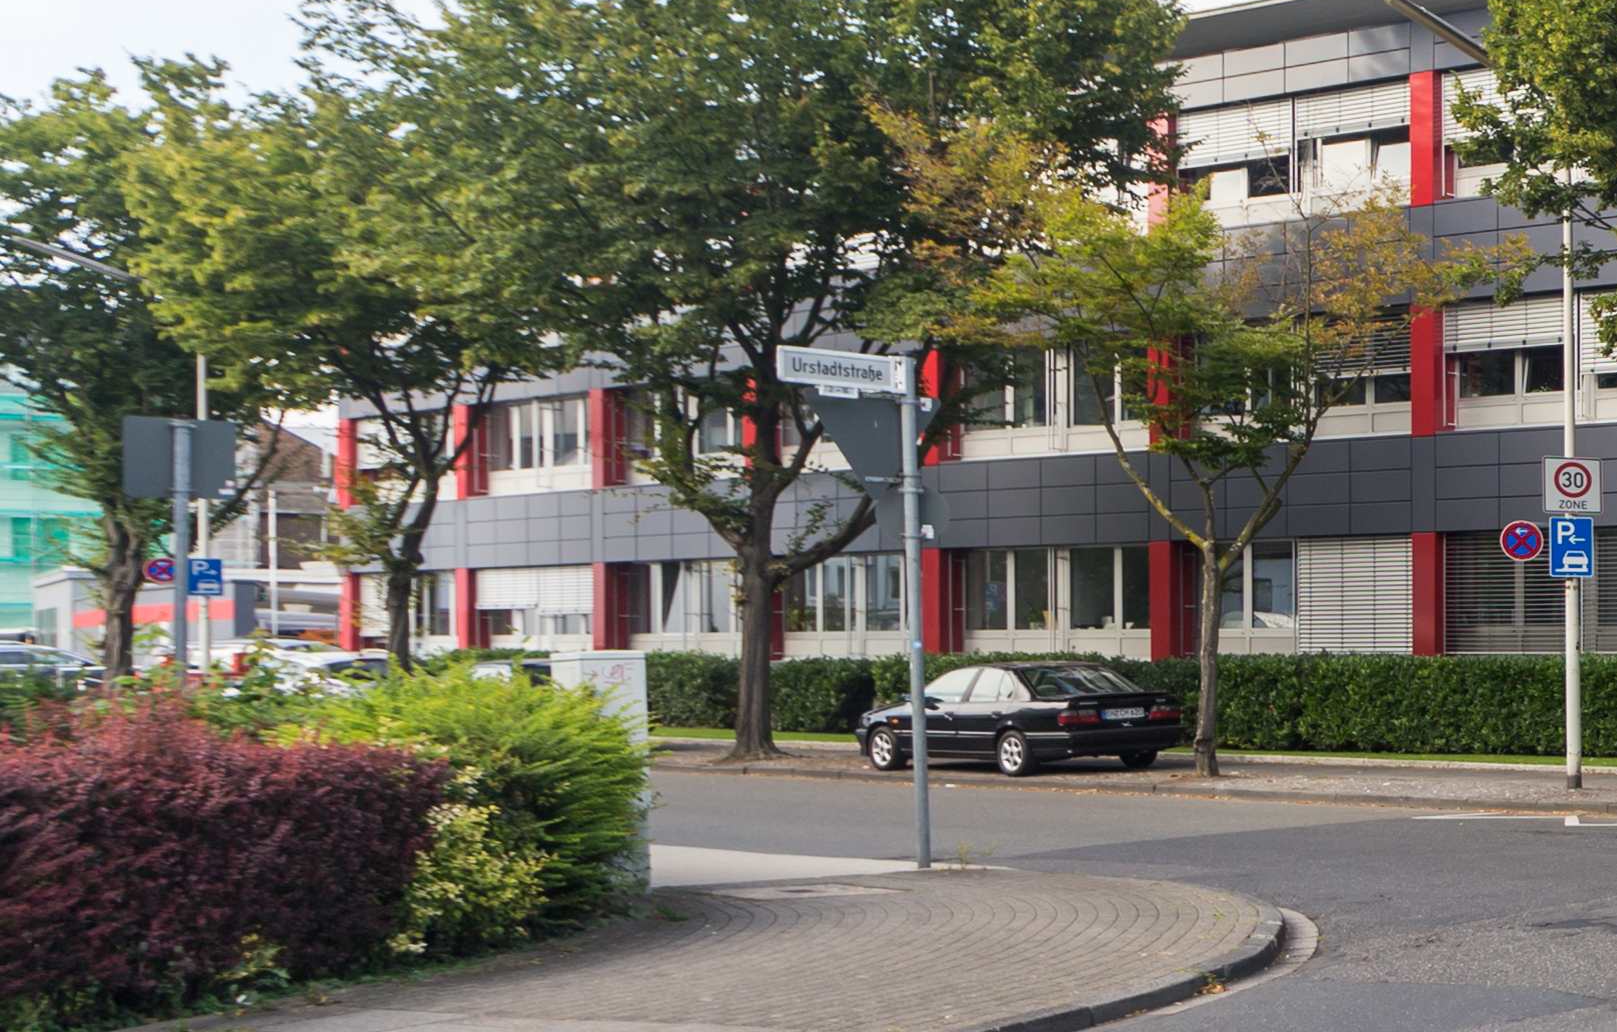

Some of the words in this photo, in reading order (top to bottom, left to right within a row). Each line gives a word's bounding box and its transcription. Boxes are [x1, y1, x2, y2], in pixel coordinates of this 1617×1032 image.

[791, 357, 883, 382] Urstadtstraße
[1562, 471, 1584, 489] 30
[1558, 499, 1588, 510] ZONE
[1557, 521, 1576, 545] P
[191, 560, 210, 576] P
